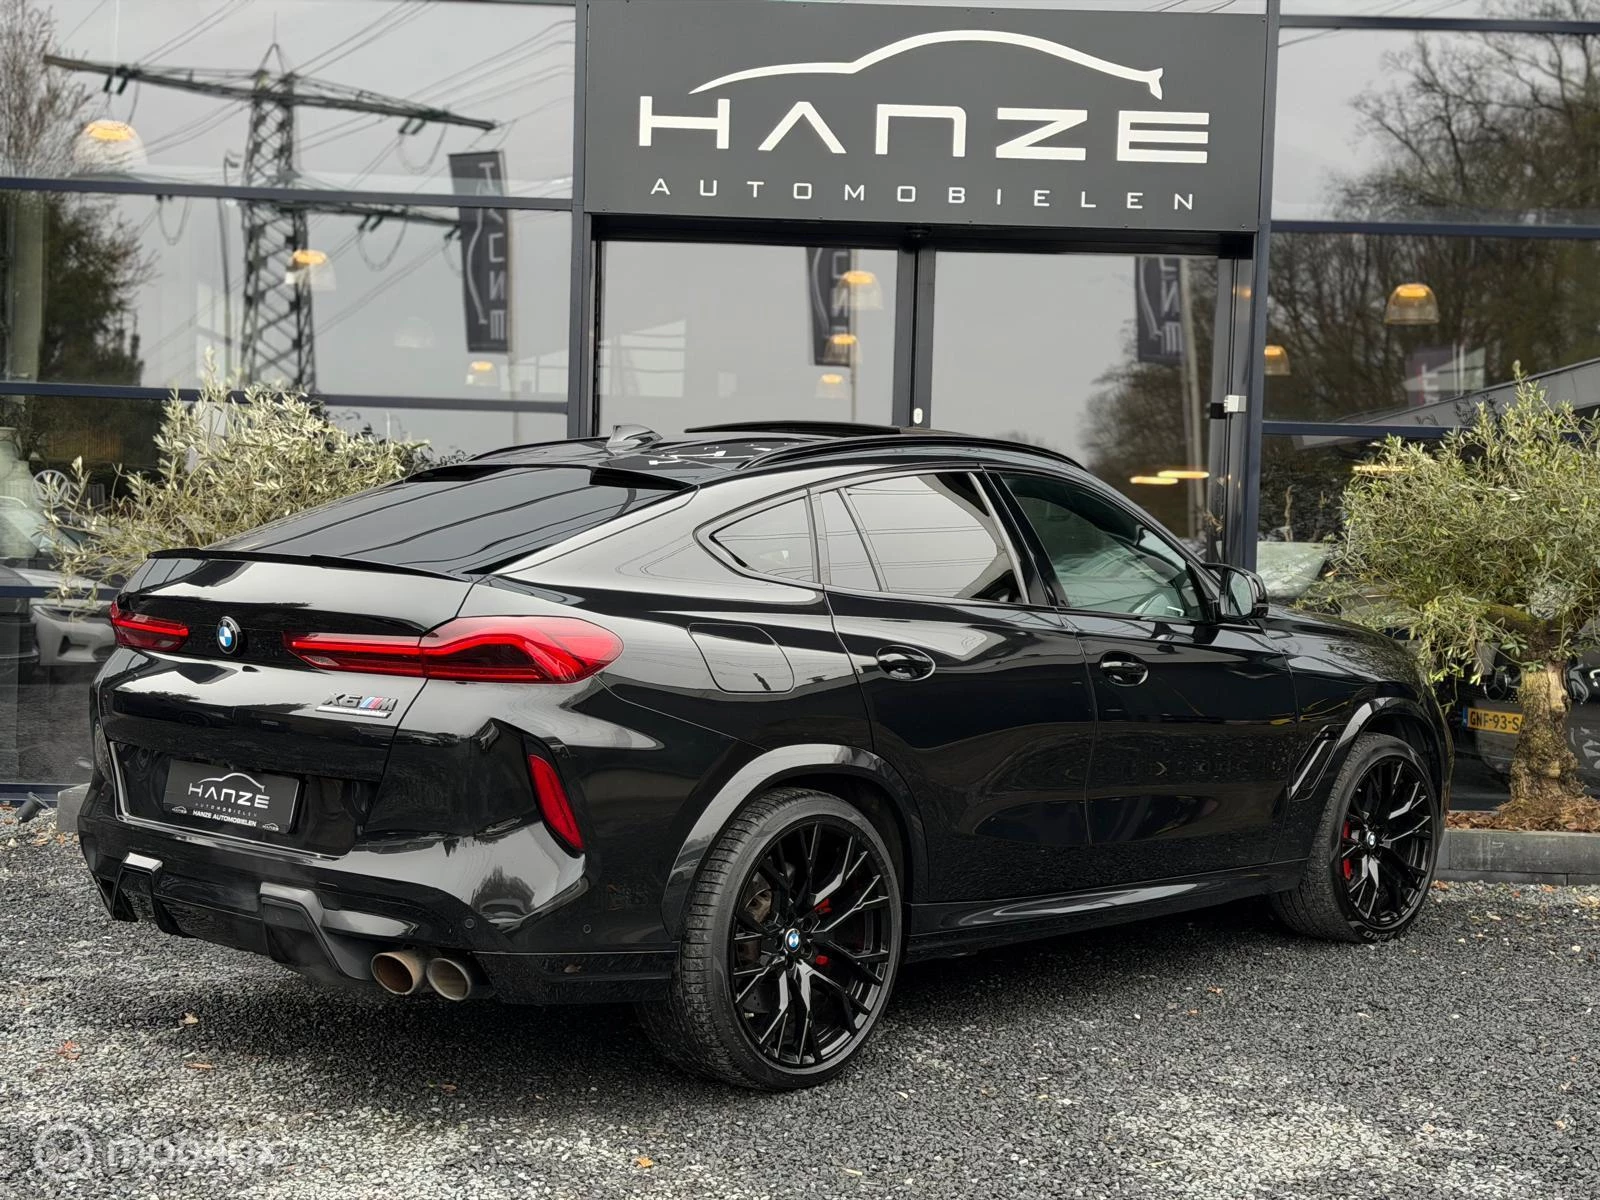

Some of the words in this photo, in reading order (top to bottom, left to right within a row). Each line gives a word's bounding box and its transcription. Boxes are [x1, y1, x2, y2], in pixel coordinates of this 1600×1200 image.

[639, 95, 1210, 164] HANZE
[650, 178, 1194, 211] AUTOMOBIELEN
[187, 782, 271, 809] HANZE
[192, 809, 213, 819] HANZE
[212, 812, 257, 828] AUTOMOBIELEN
